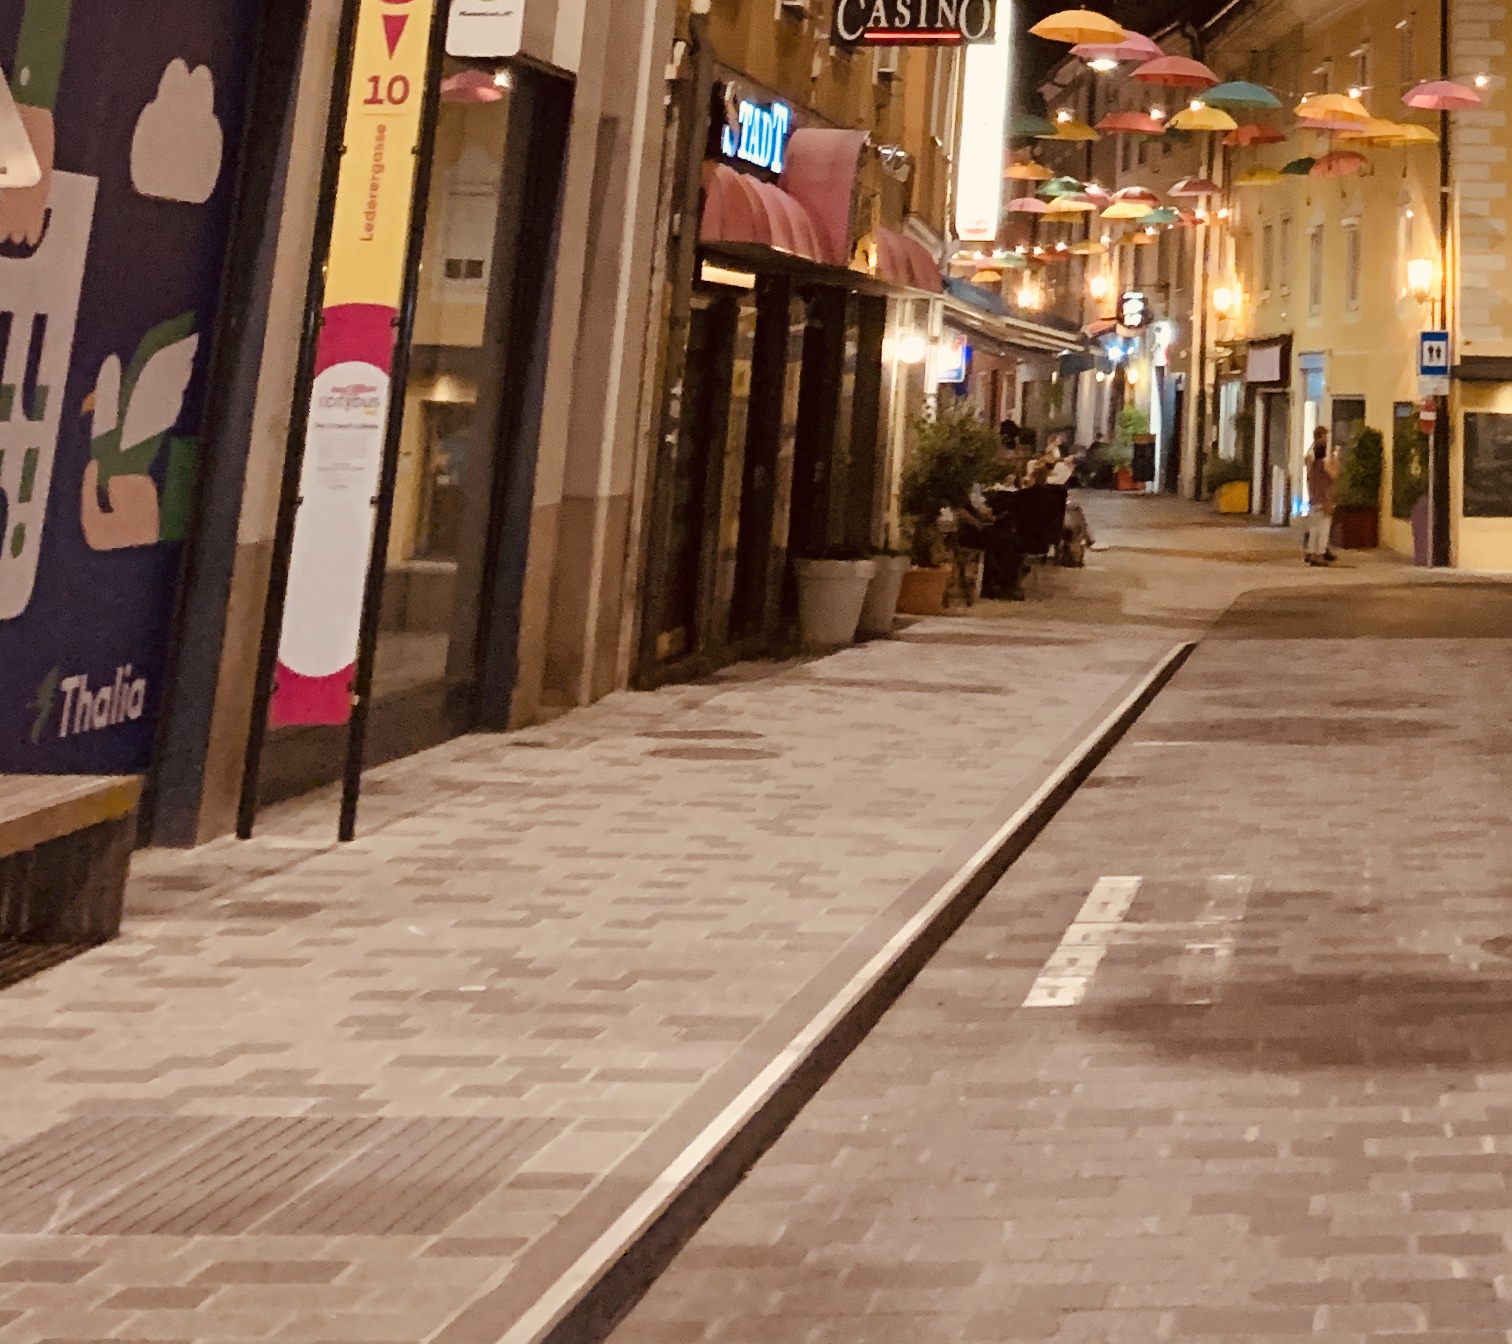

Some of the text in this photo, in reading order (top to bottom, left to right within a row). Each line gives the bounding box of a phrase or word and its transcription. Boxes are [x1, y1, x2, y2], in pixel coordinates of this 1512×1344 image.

[363, 74, 410, 105] 10
[359, 123, 387, 243] Lederergasse
[59, 663, 147, 738] Thalia
